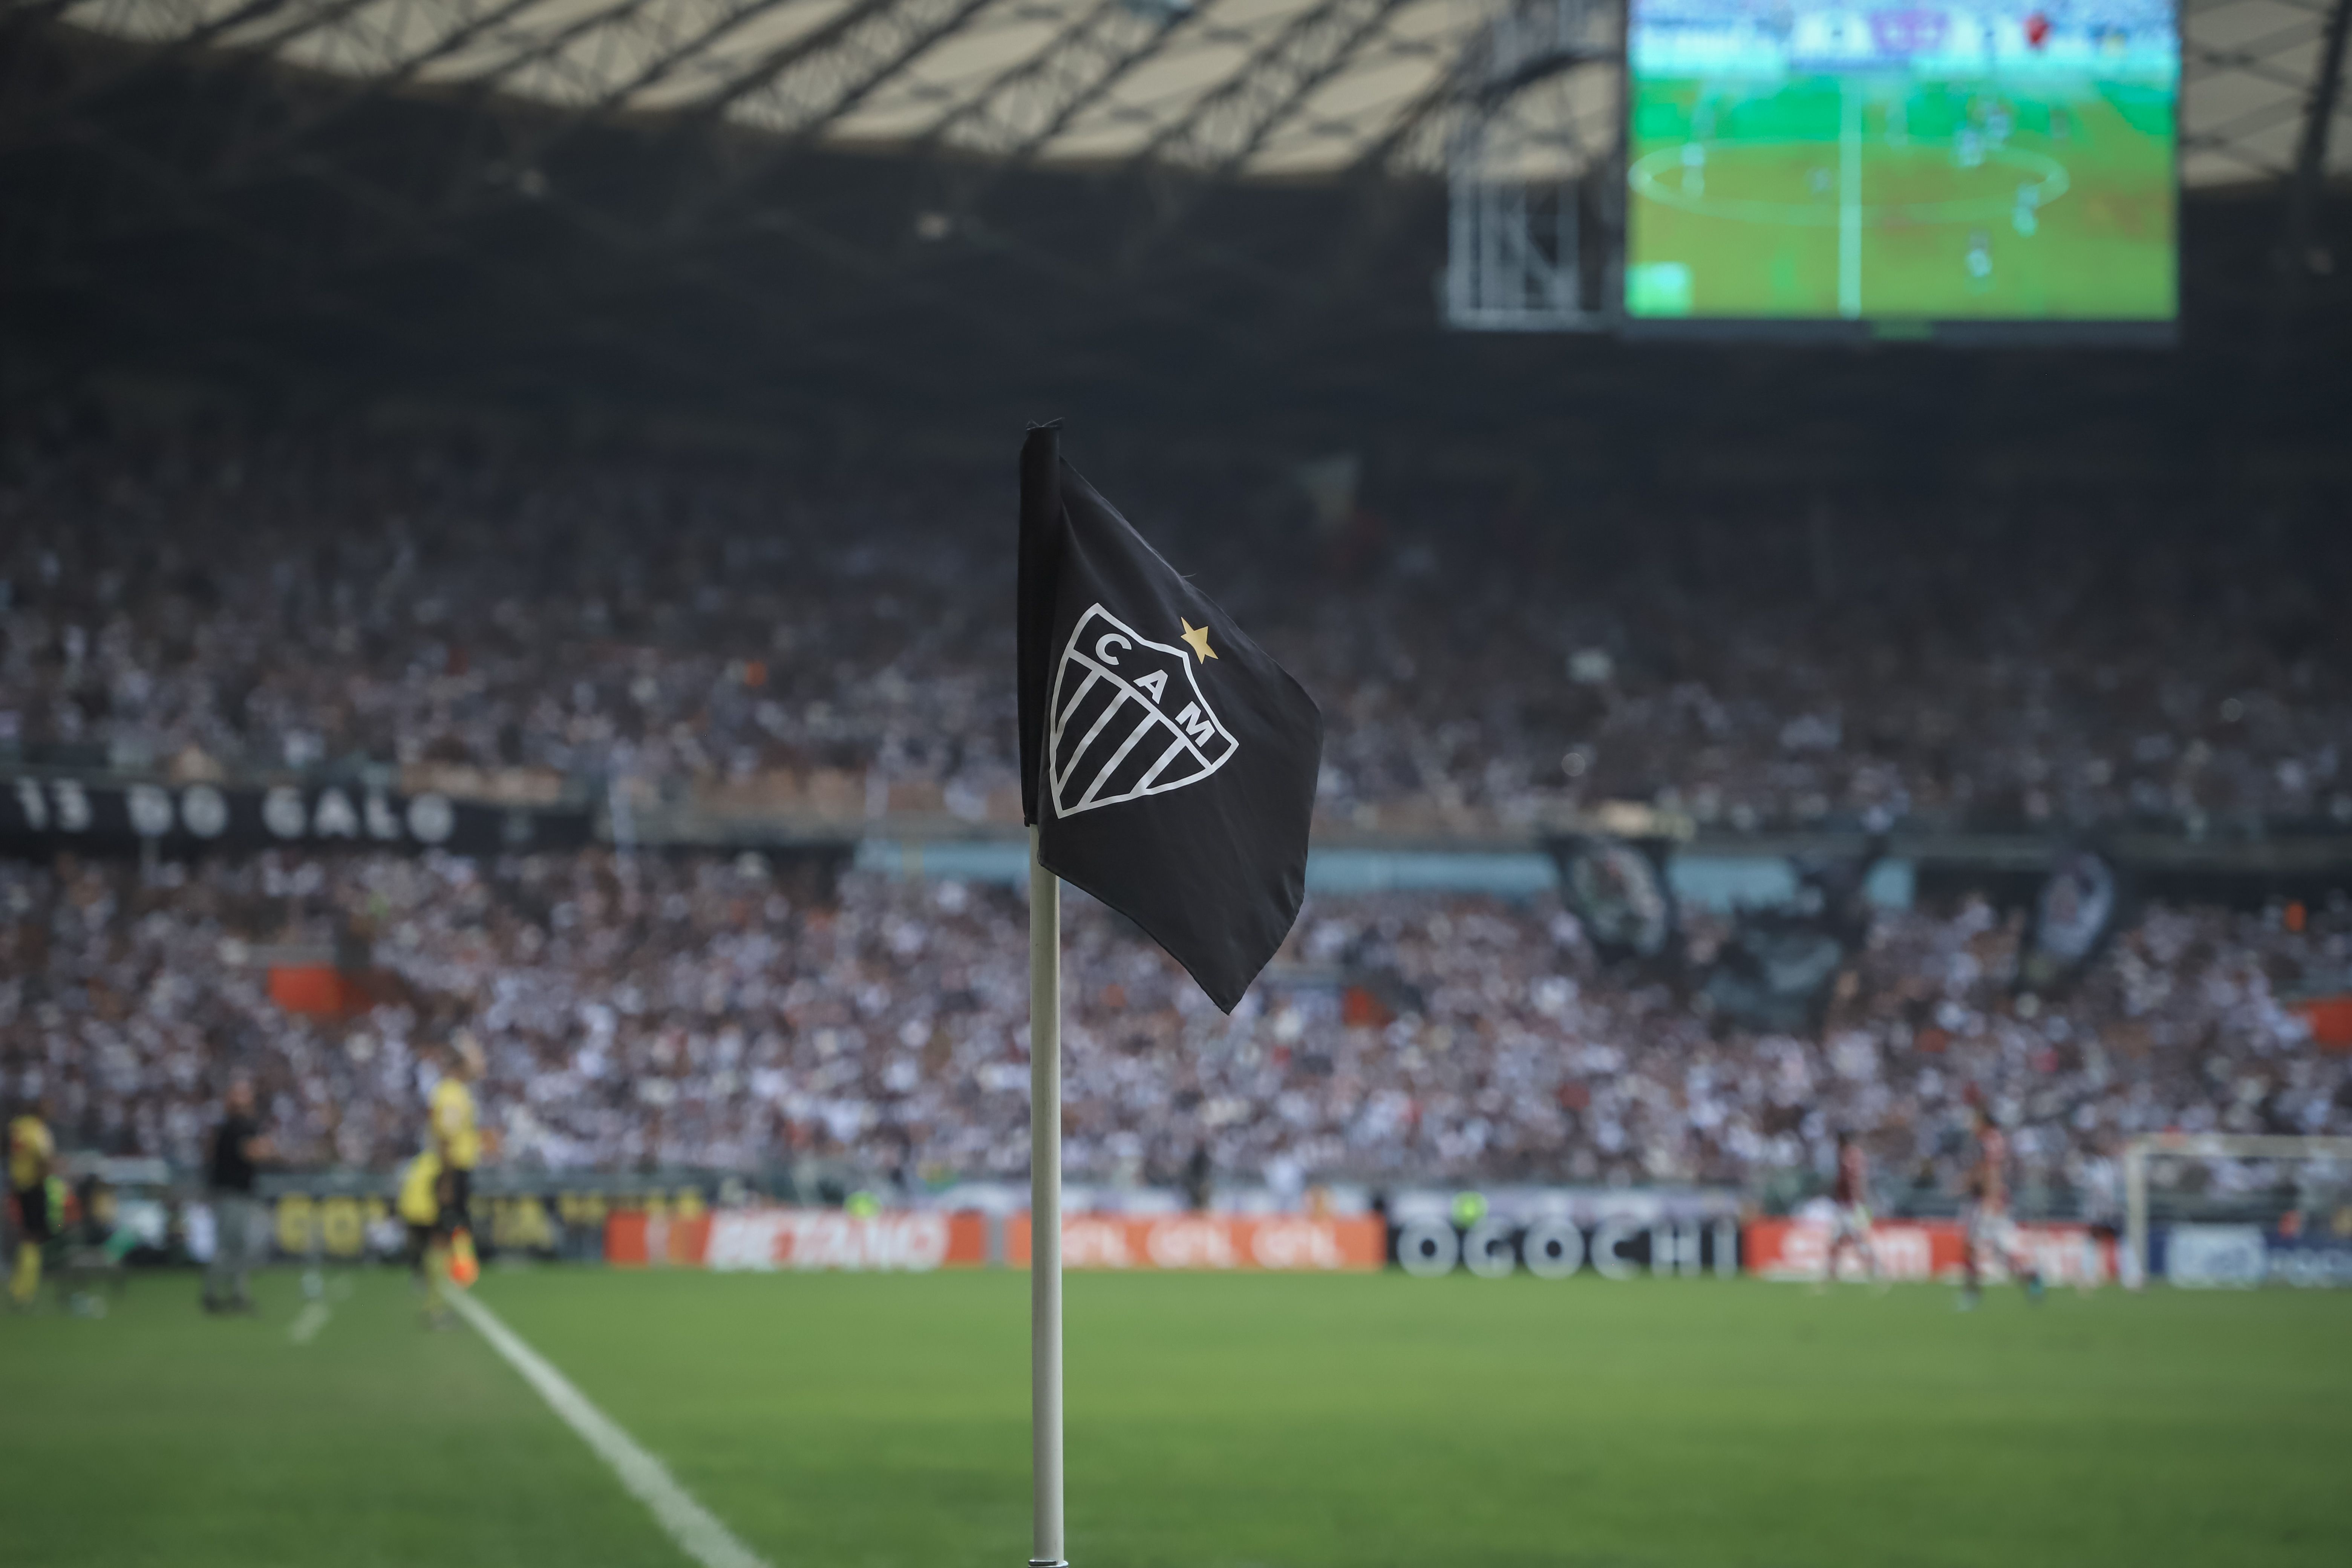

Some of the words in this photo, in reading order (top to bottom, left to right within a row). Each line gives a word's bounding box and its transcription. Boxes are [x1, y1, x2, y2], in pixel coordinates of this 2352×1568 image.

[1095, 633, 1216, 747] CAM
[124, 781, 229, 839] DO
[262, 783, 456, 843] GALO
[704, 1208, 949, 1272] BETANO
[1396, 1216, 1738, 1282] OGOCHI
